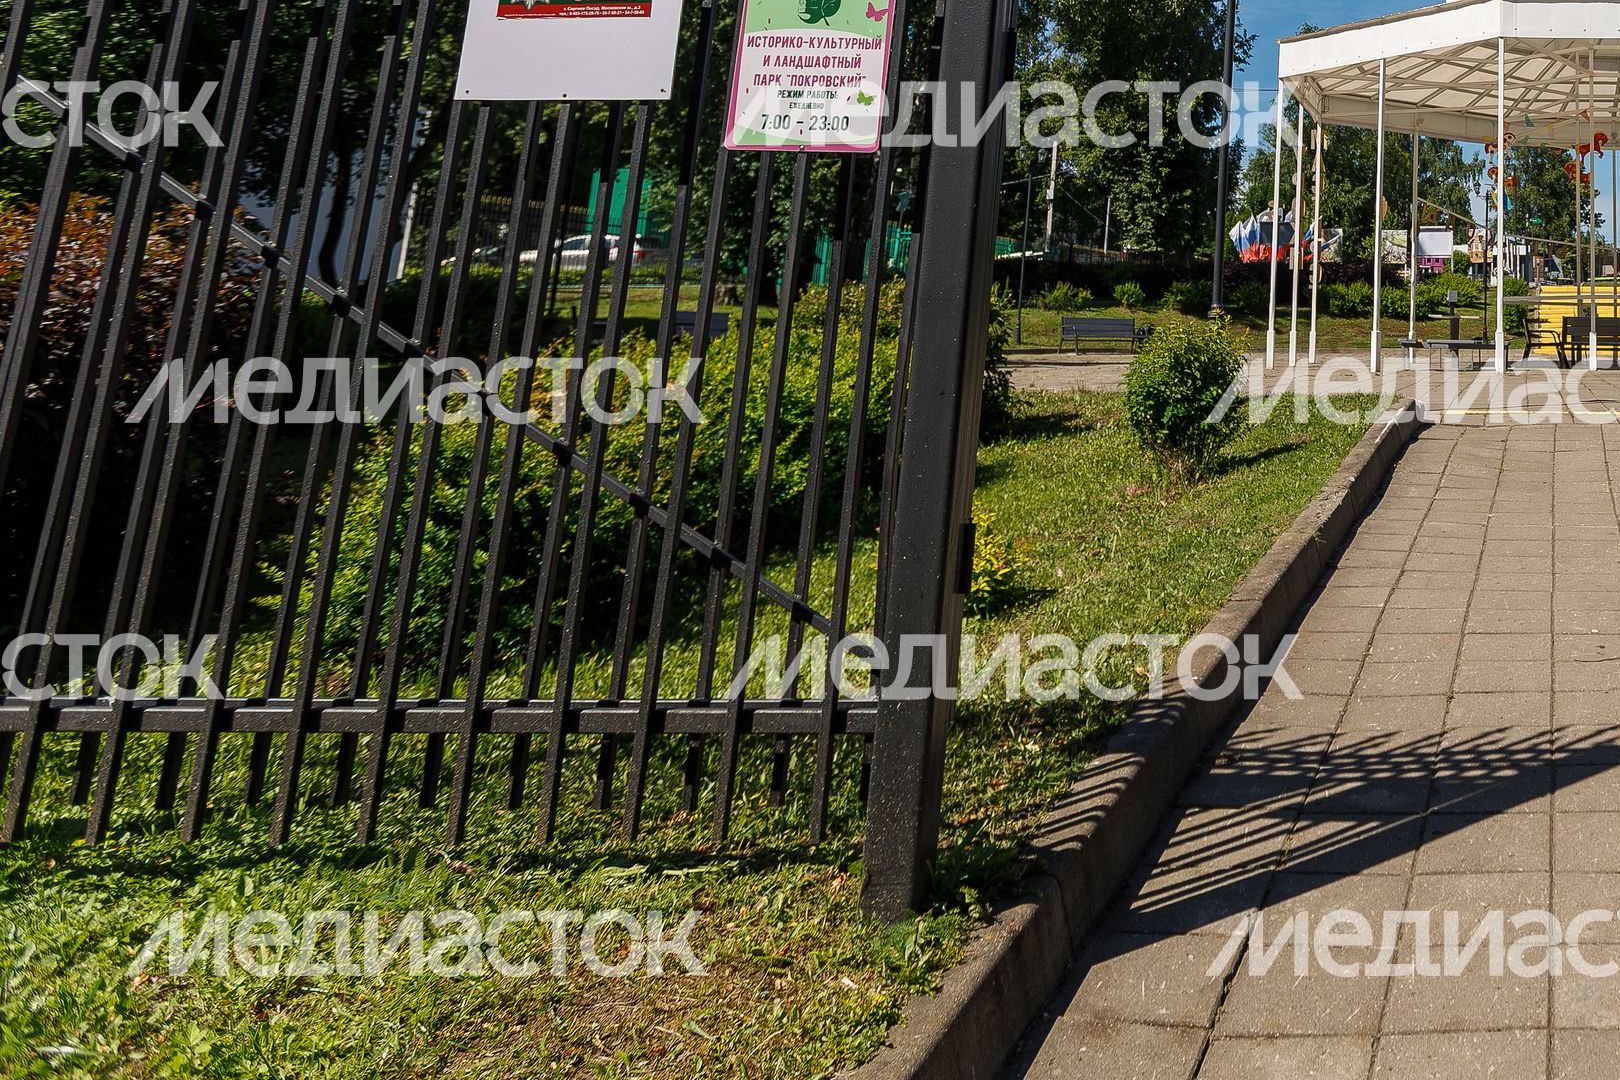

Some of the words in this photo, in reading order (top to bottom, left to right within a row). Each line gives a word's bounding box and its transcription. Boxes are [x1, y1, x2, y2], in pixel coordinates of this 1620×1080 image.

[747, 35, 882, 50] ИСТОРИКО-КУЛЬТУРНЫЙ
[762, 55, 770, 67] И
[774, 54, 862, 69] ЛАНДШАФТНЫЙ
[753, 74, 782, 86] ПАРК
[777, 90, 804, 99] РЕЖИМ
[761, 114, 791, 130] 7:00
[809, 115, 850, 132] 23:00
